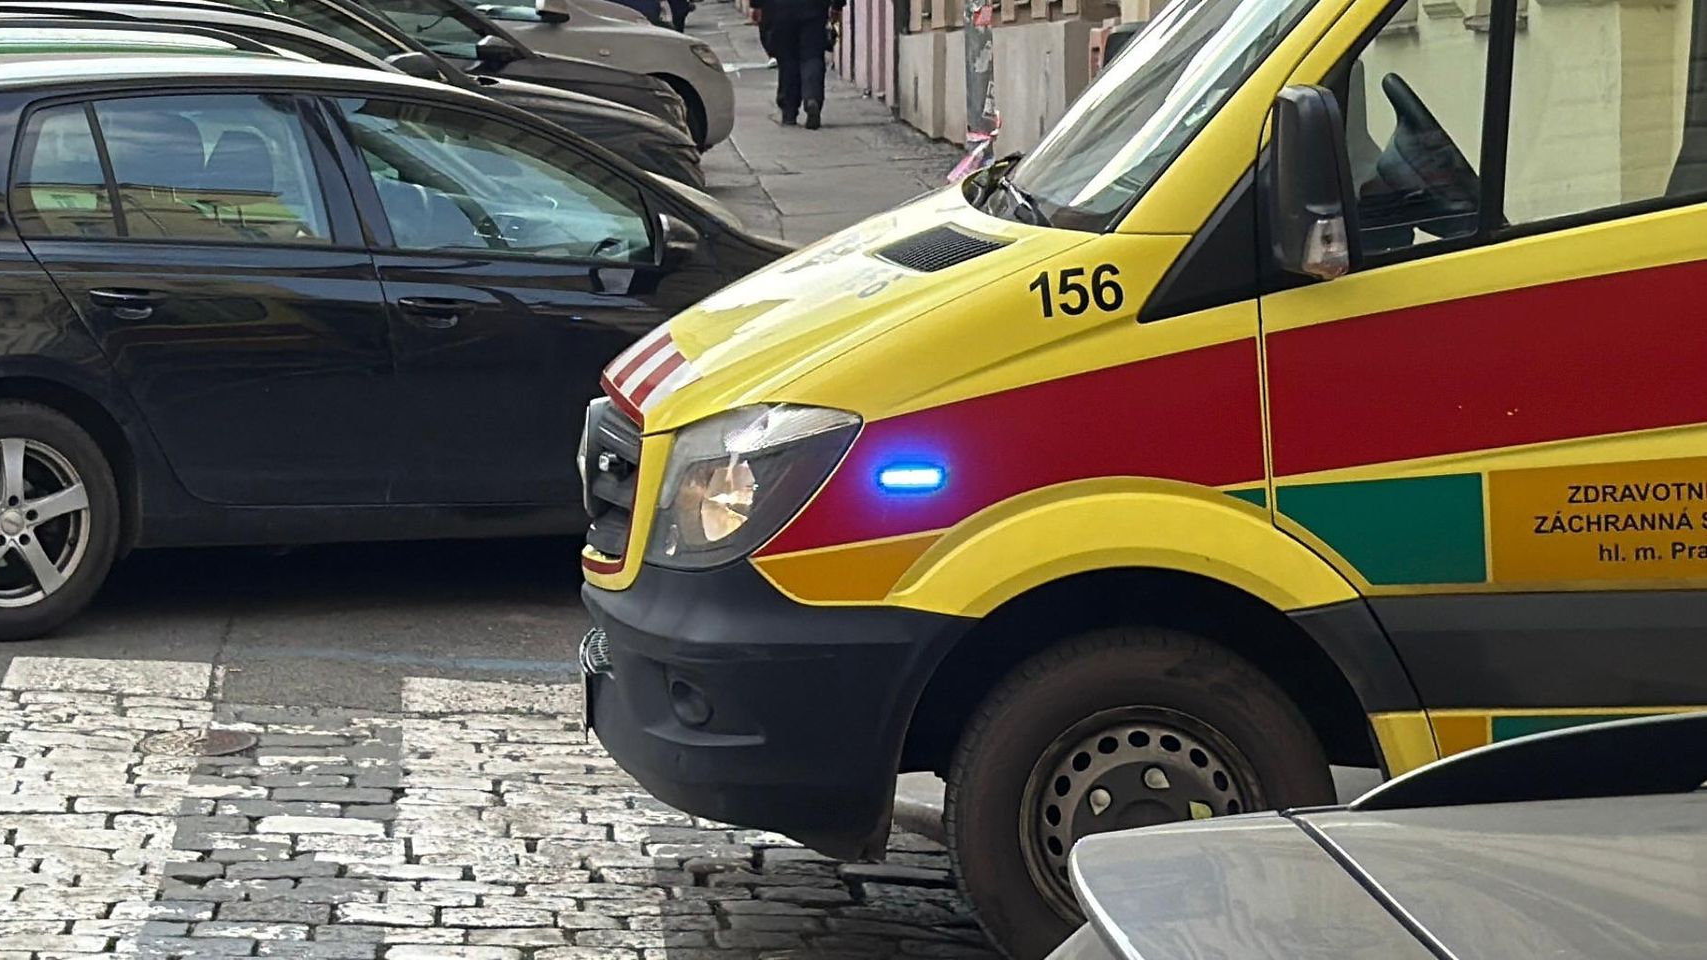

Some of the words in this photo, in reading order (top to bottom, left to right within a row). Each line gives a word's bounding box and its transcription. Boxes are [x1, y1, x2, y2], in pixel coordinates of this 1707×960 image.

[1029, 263, 1124, 318] 156
[1533, 507, 1694, 534] ZÁCHRANNÁ
[1598, 543, 1626, 561] hl.
[1634, 546, 1662, 561] m.
